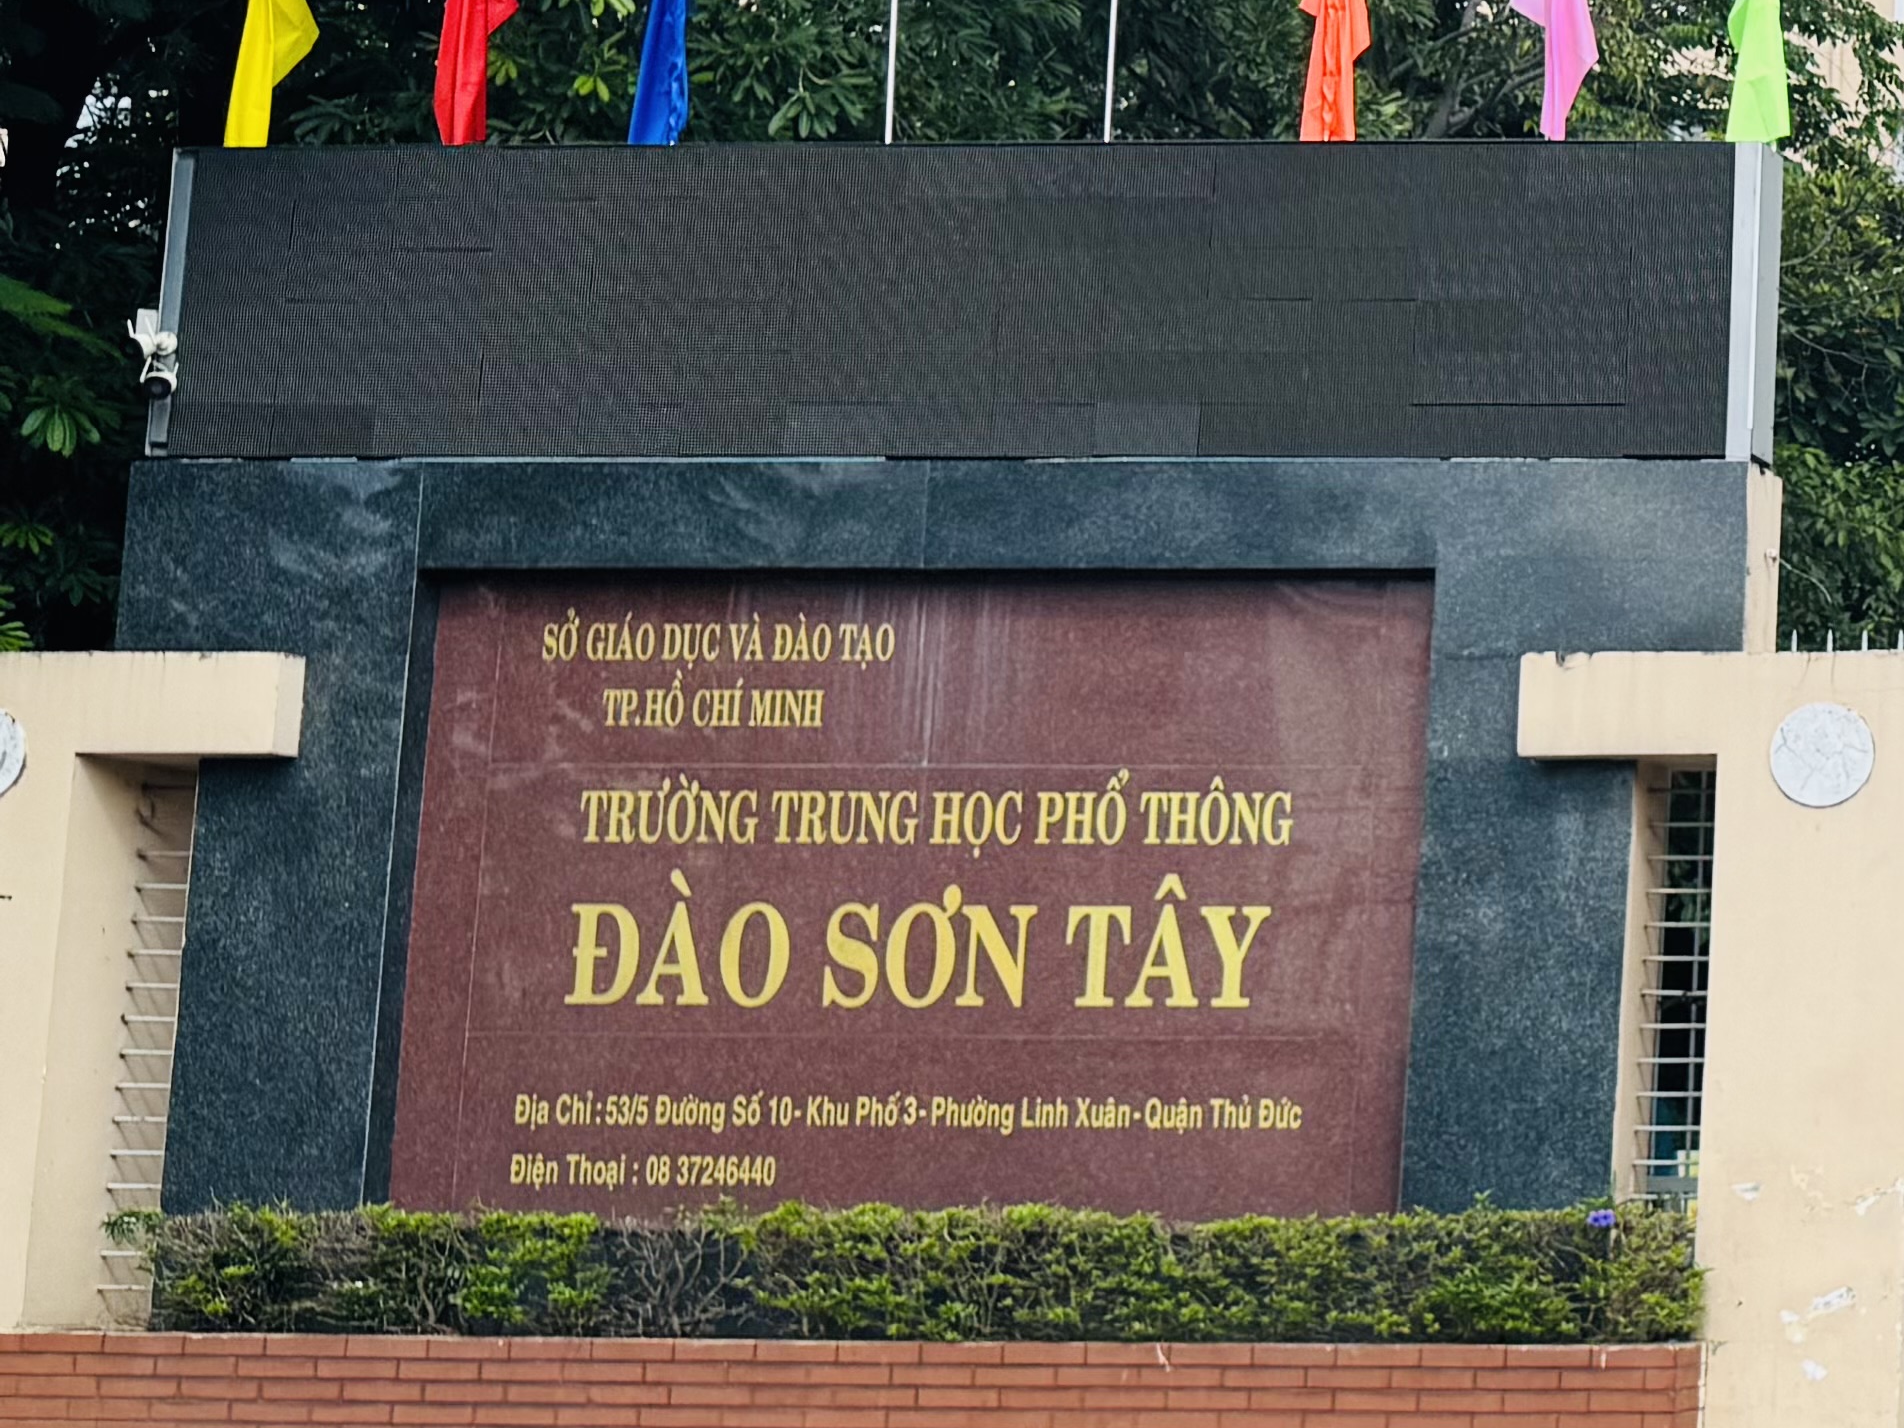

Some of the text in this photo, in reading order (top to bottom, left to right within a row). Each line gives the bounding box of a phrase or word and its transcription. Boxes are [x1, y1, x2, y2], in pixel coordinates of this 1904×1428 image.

[542, 606, 895, 670] SỞ GIÁO DỤC VÀ ĐÀO TẠO
[692, 676, 744, 727] CHÍ
[748, 689, 825, 727] MINH
[580, 768, 1294, 859] TRƯỜNG TRUNG HỌC PHỔ THÔNG
[564, 868, 1272, 1008] ĐÀO SƠN TÂY
[515, 1094, 549, 1131] Địa
[605, 1096, 649, 1126] 53/5
[655, 1094, 725, 1133] Đường
[732, 1090, 764, 1126] Số
[807, 1096, 849, 1126] Khu
[855, 1090, 902, 1126] Phố
[931, 1094, 1015, 1135] Phường
[1021, 1097, 1069, 1128] Linh
[1211, 1093, 1251, 1129] Thủ
[1258, 1096, 1302, 1129] Đức
[510, 1152, 558, 1190] Điện
[566, 1153, 626, 1190] Thoại
[646, 1155, 671, 1187] 08
[676, 1155, 776, 1187] 37246440
